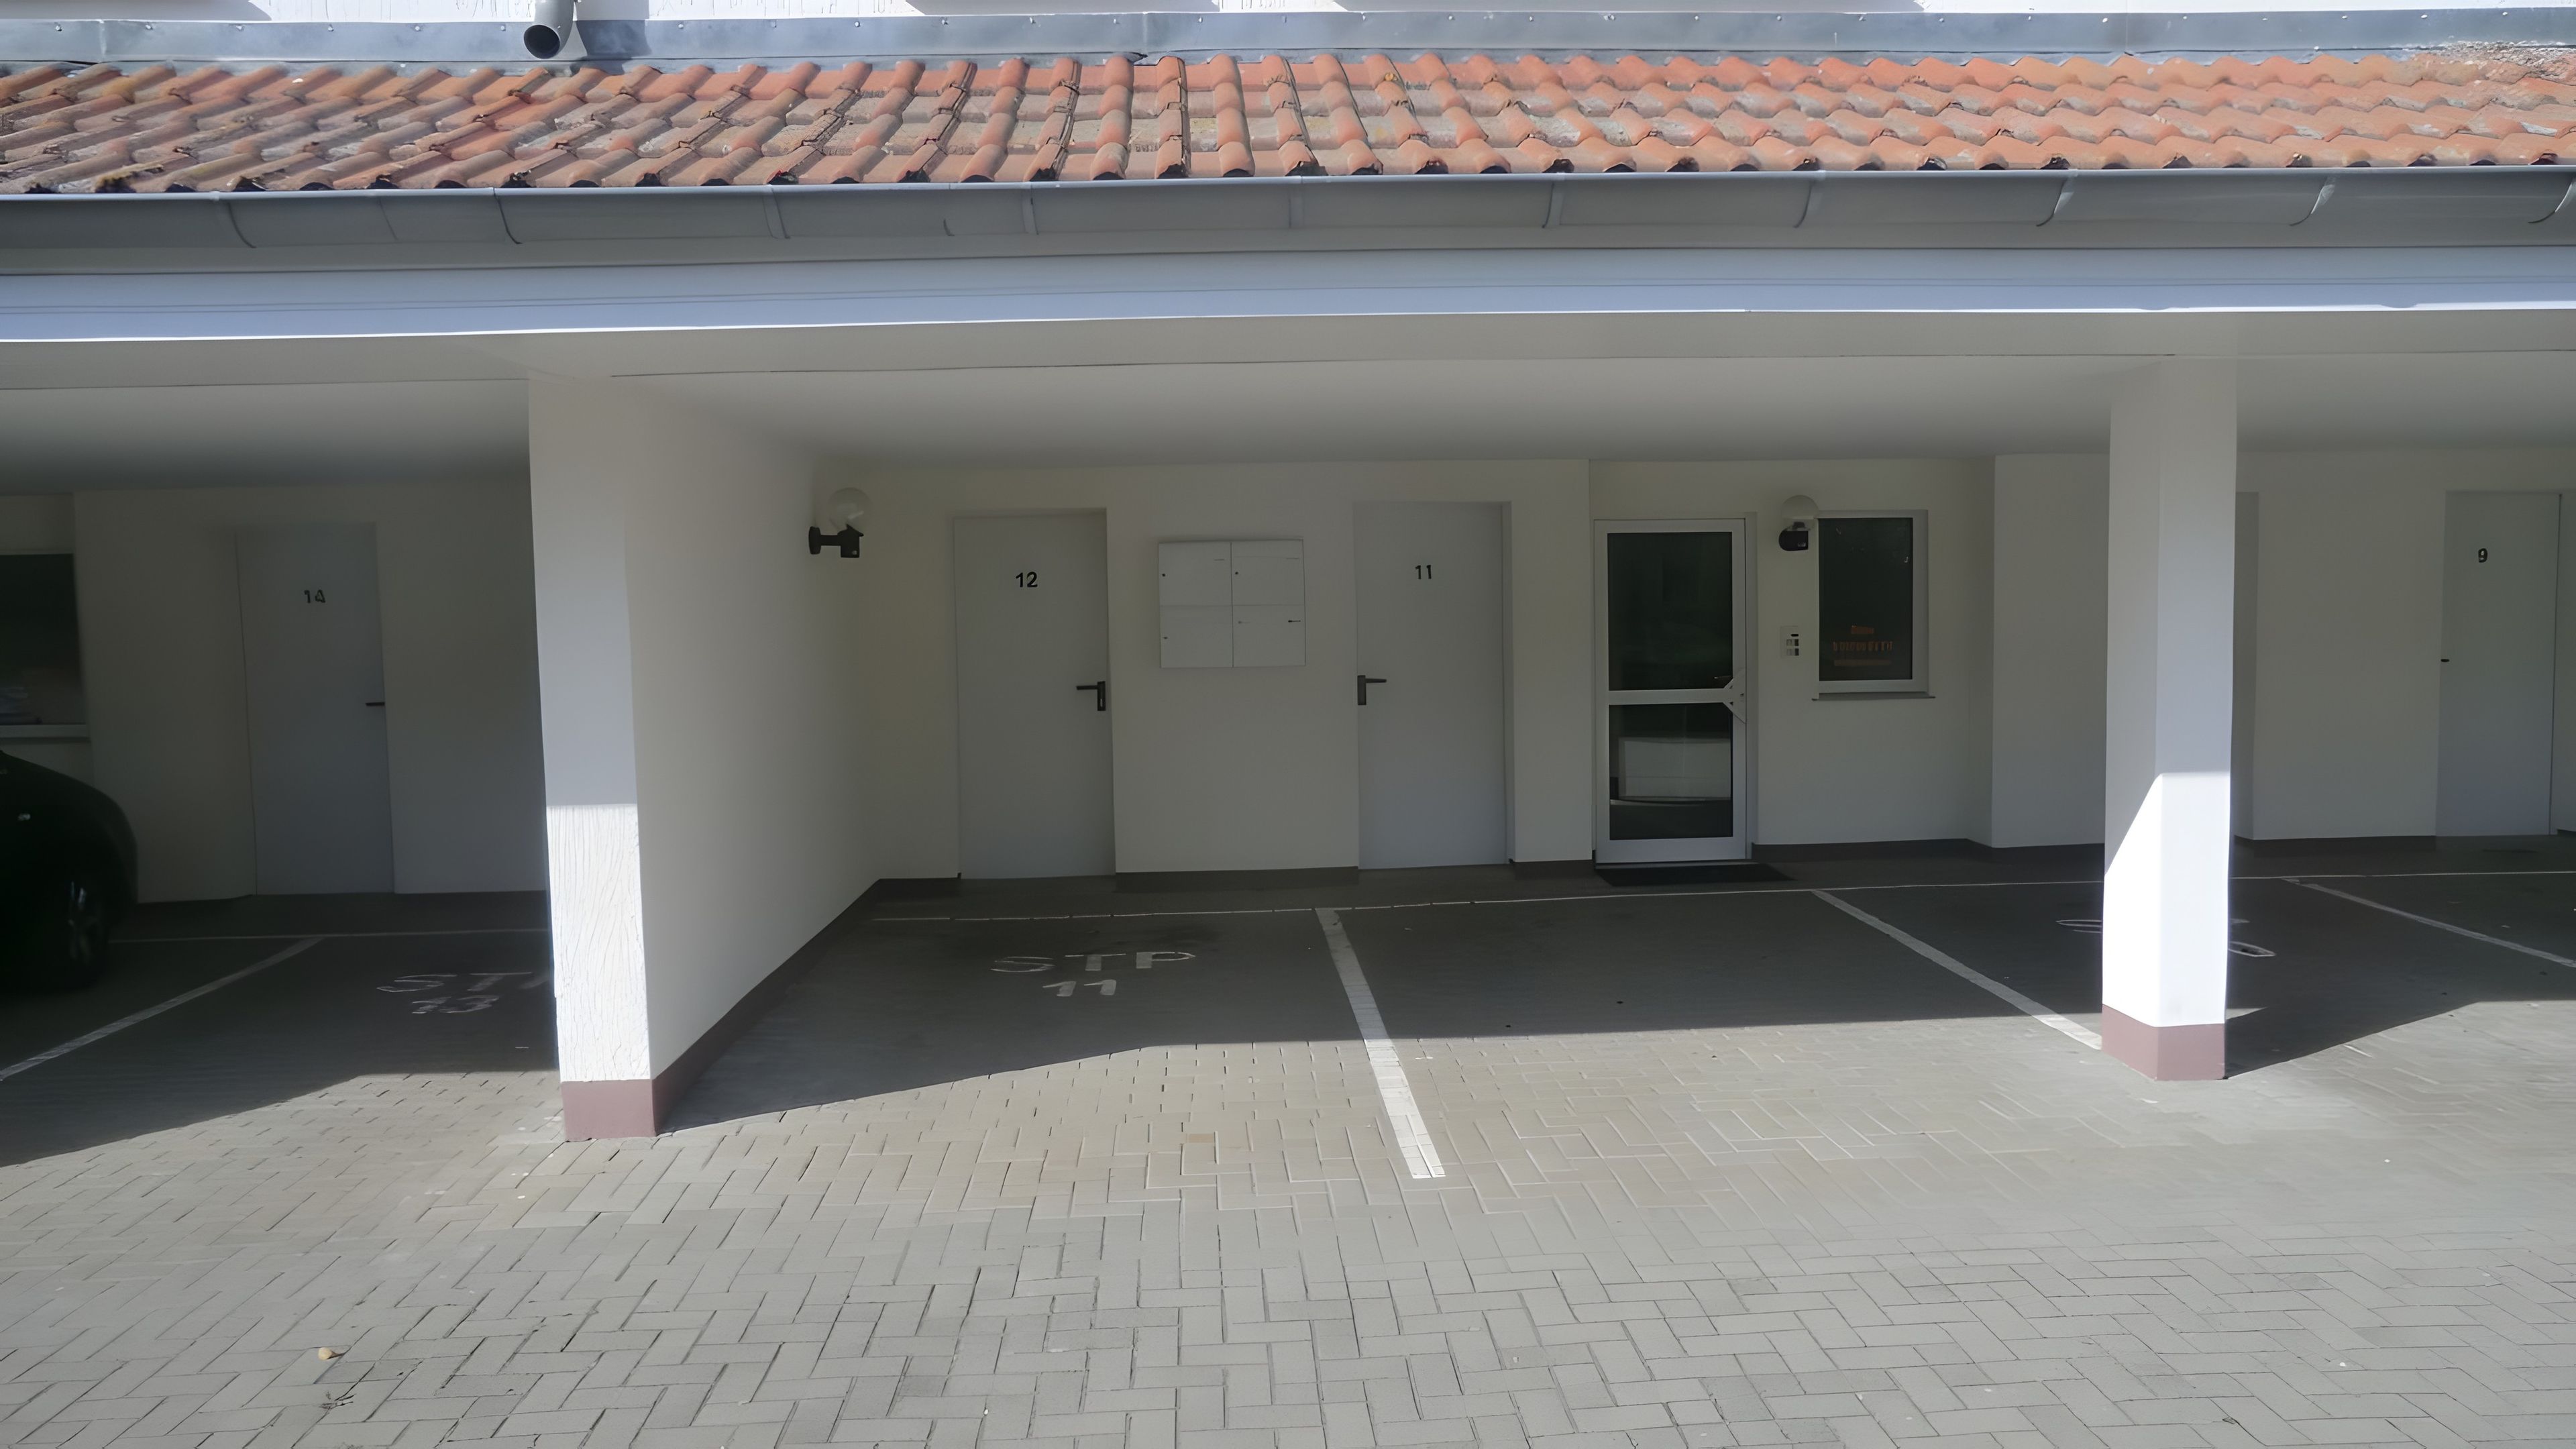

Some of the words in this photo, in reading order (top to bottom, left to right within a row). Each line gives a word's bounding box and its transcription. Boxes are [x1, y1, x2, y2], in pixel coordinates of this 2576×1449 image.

[2477, 547, 2488, 564] 9
[1015, 571, 1038, 588] 12
[1415, 564, 1432, 580] 11
[304, 589, 326, 604] 14
[990, 951, 1196, 972] STP
[1042, 979, 1117, 997] 11
